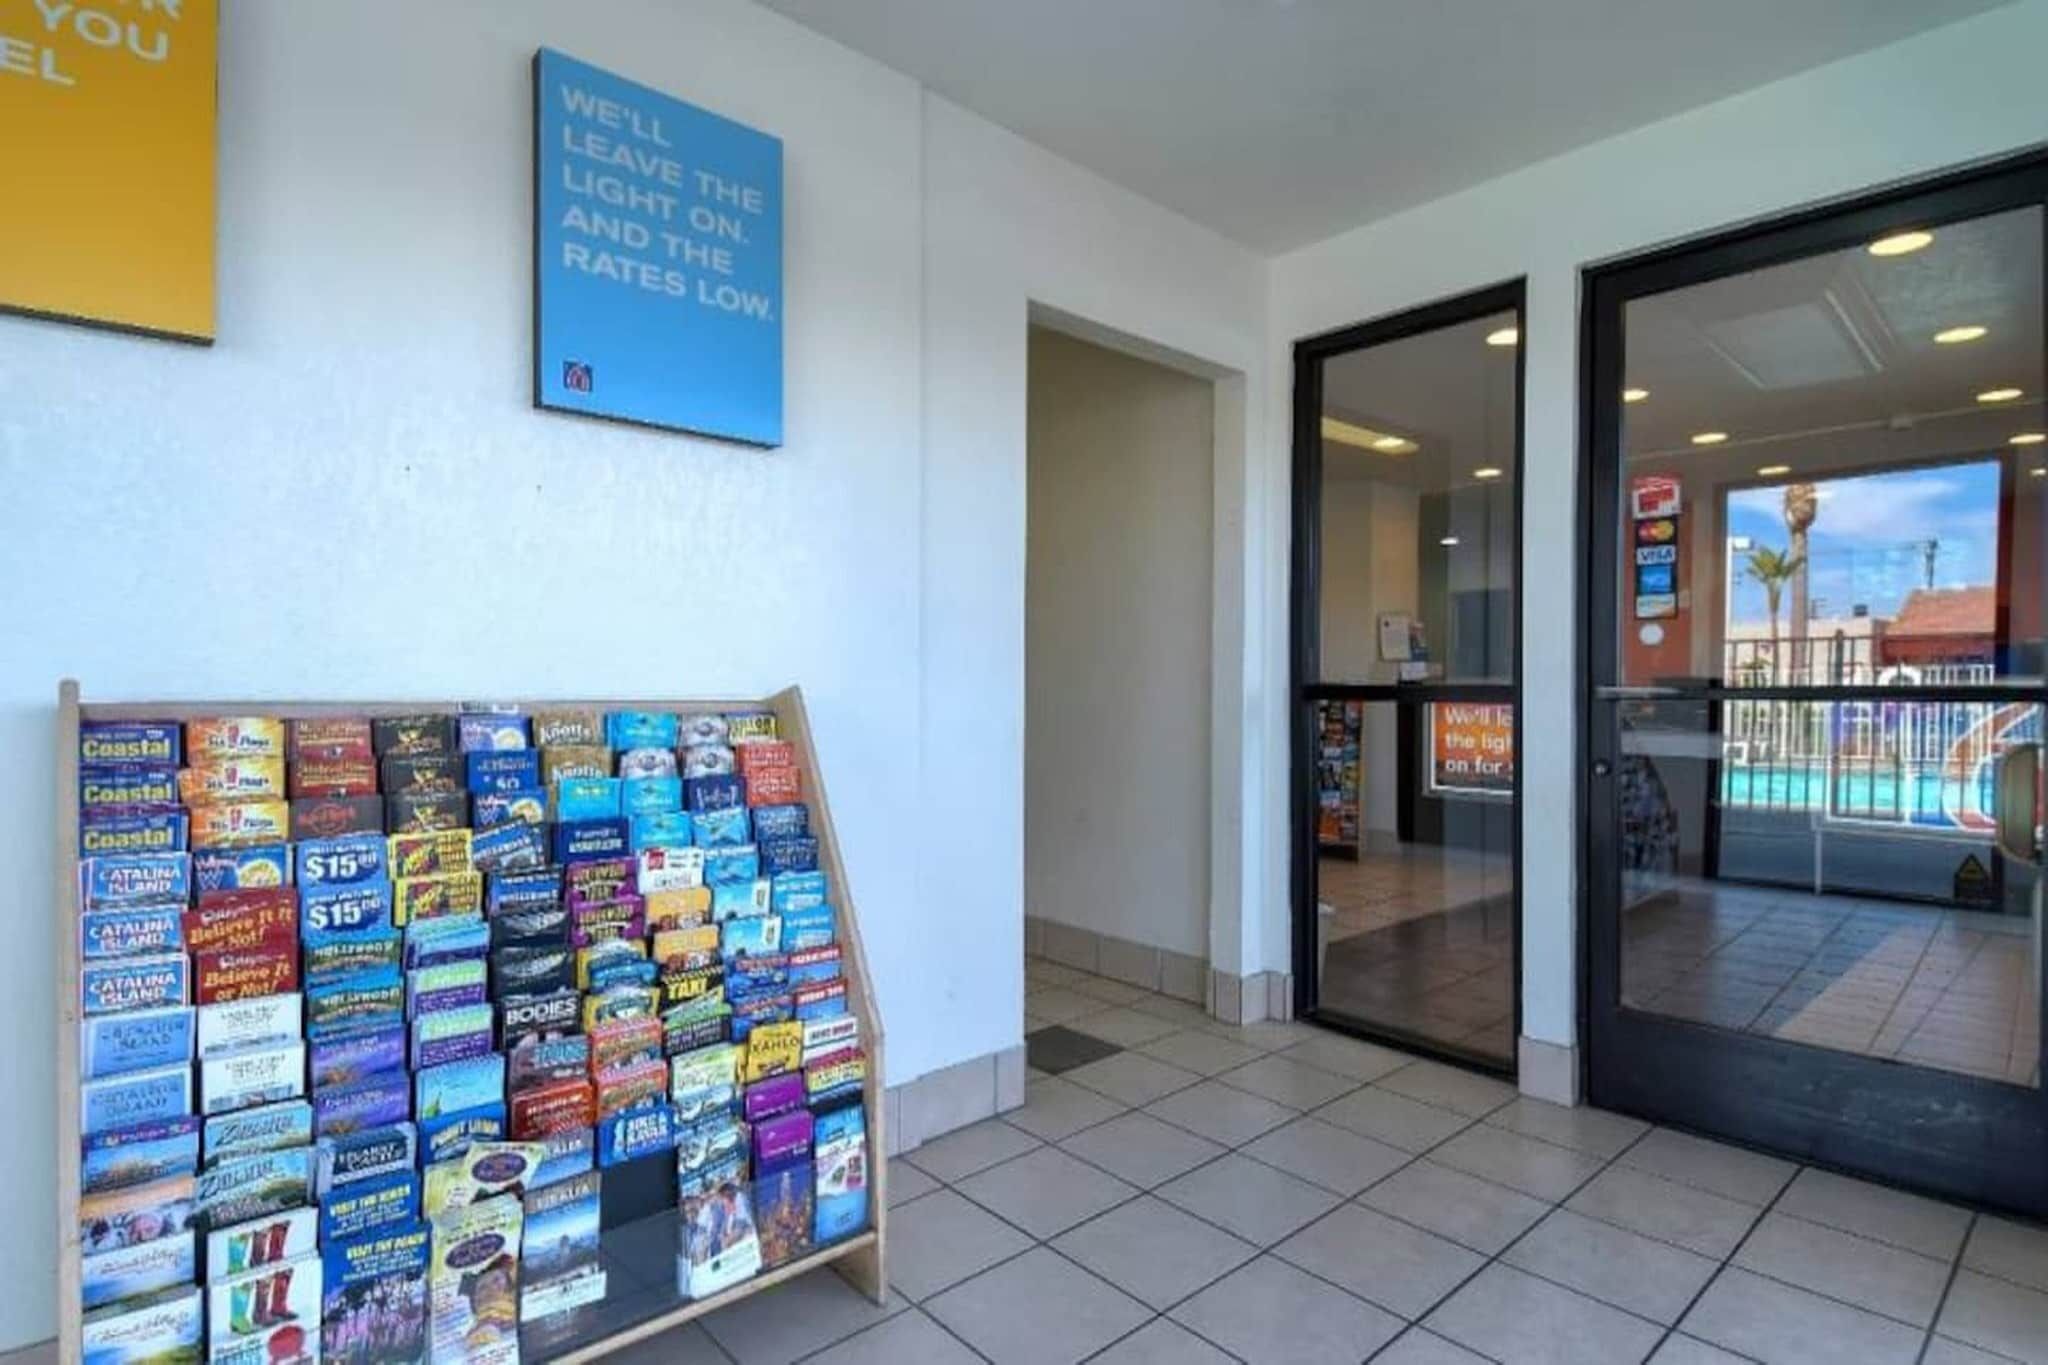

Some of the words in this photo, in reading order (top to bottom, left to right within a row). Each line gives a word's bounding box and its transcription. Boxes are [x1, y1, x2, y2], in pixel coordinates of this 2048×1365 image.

[33, 0, 169, 62] YOU
[561, 83, 673, 149] WE'LL
[563, 123, 683, 189] LEAVE
[694, 169, 764, 216] THE
[563, 163, 681, 221] LIGHT
[689, 206, 751, 245] ON.
[561, 204, 651, 250] AND
[661, 231, 734, 276] THE
[563, 241, 687, 298] RATES
[697, 278, 775, 323] LOW.
[1640, 550, 1674, 563] VISA
[1446, 704, 1490, 727] We'll
[83, 737, 171, 759] Coastal
[1446, 732, 1476, 750] the
[1446, 758, 1470, 774] on
[1475, 755, 1504, 775] for
[84, 782, 172, 804] Coastal
[84, 826, 174, 850] Coastal
[100, 861, 181, 882] CATALINA
[305, 852, 358, 880] $15
[108, 877, 173, 895] ISLAND
[309, 901, 362, 930] $15
[89, 917, 175, 939] CATALINA
[100, 933, 167, 951] ISLAND
[89, 971, 176, 994] CATALINA
[204, 966, 271, 988] Believe
[100, 987, 167, 1006] ISLAND
[505, 997, 578, 1026] BODIES
[752, 1034, 801, 1055] KAHLO
